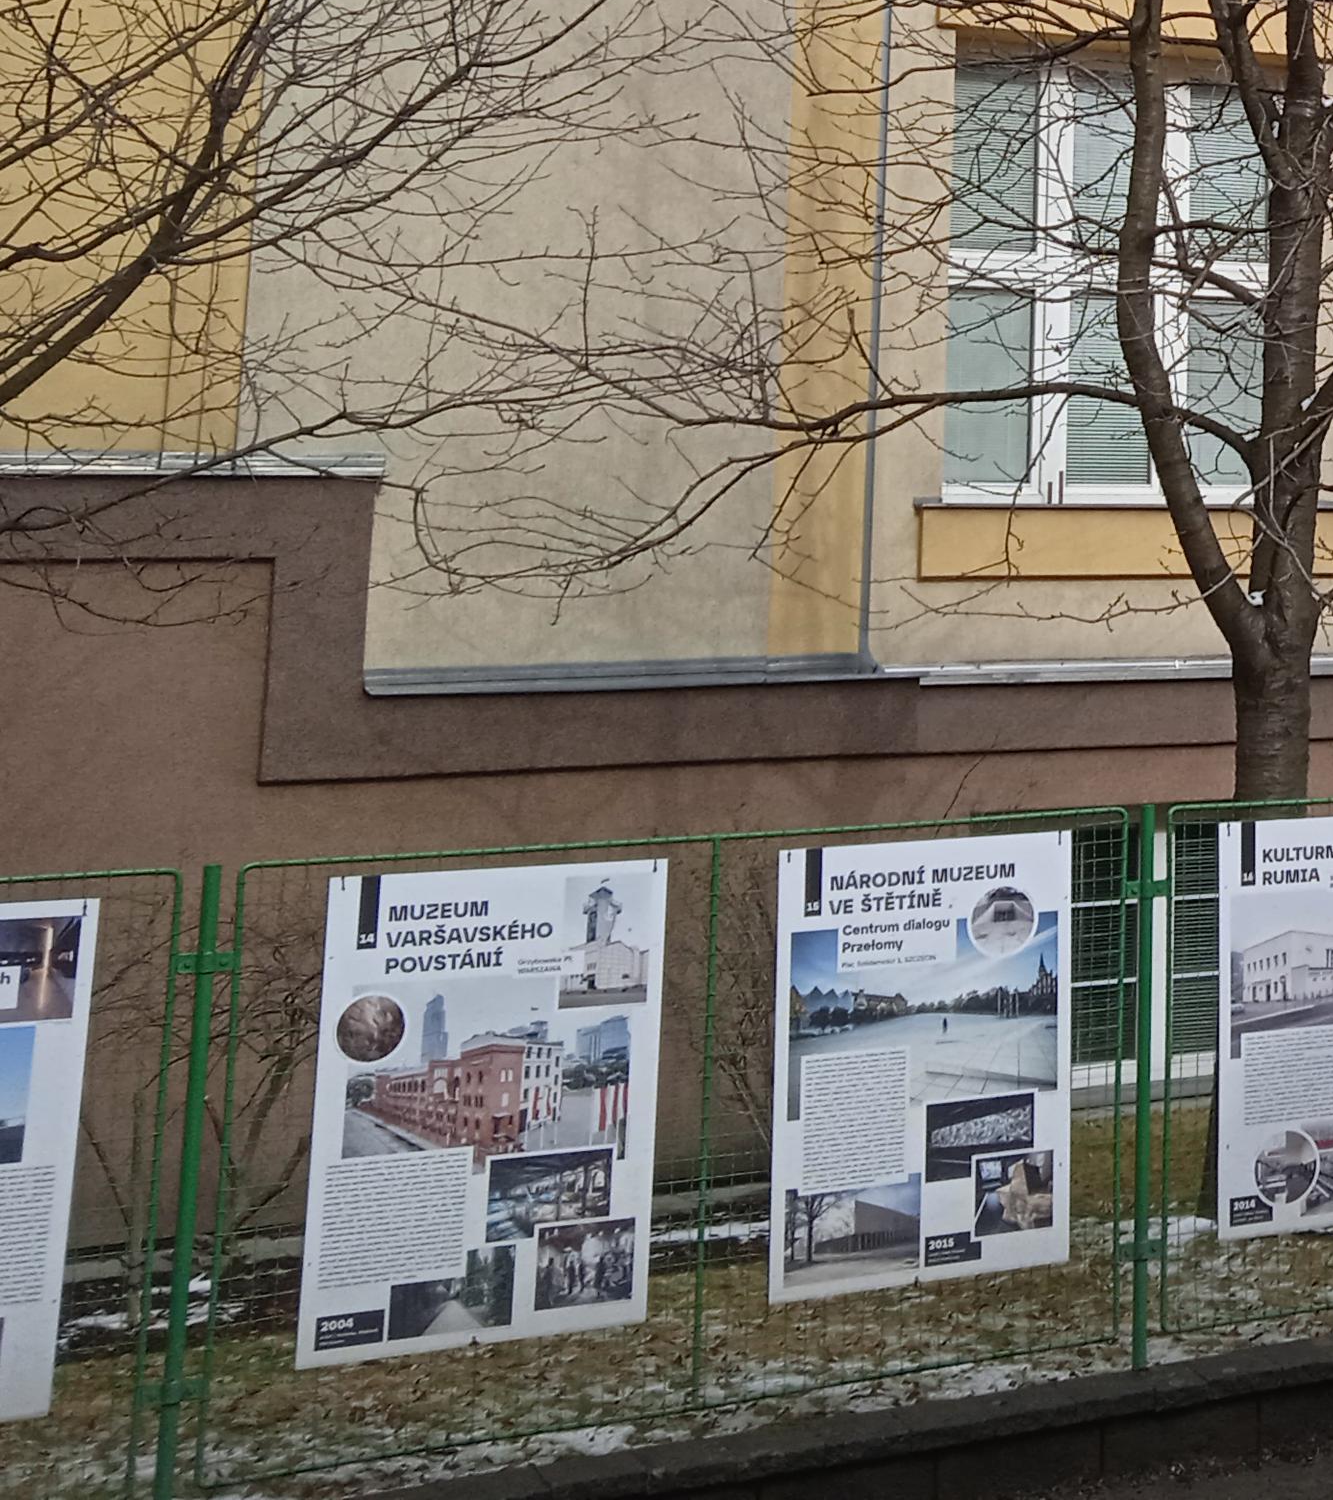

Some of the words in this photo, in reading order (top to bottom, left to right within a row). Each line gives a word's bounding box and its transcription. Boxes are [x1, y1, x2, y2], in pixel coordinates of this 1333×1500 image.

[830, 865, 925, 891] NÁRODNÍ
[932, 863, 1015, 884] MUZEUM
[1262, 868, 1320, 886] RUMIA
[388, 900, 489, 922] MUZEUM
[829, 899, 854, 915] VE
[860, 888, 942, 913] ŠTĚTÍNĚ
[386, 920, 553, 948] VARŠAVSKÉHO
[842, 923, 900, 936] Centrum
[903, 918, 951, 933] dialogu
[841, 939, 904, 953] Przełomy
[385, 946, 504, 975] POVSTÁNÍ
[927, 1237, 955, 1250] 2015
[319, 1317, 354, 1332] 2004
